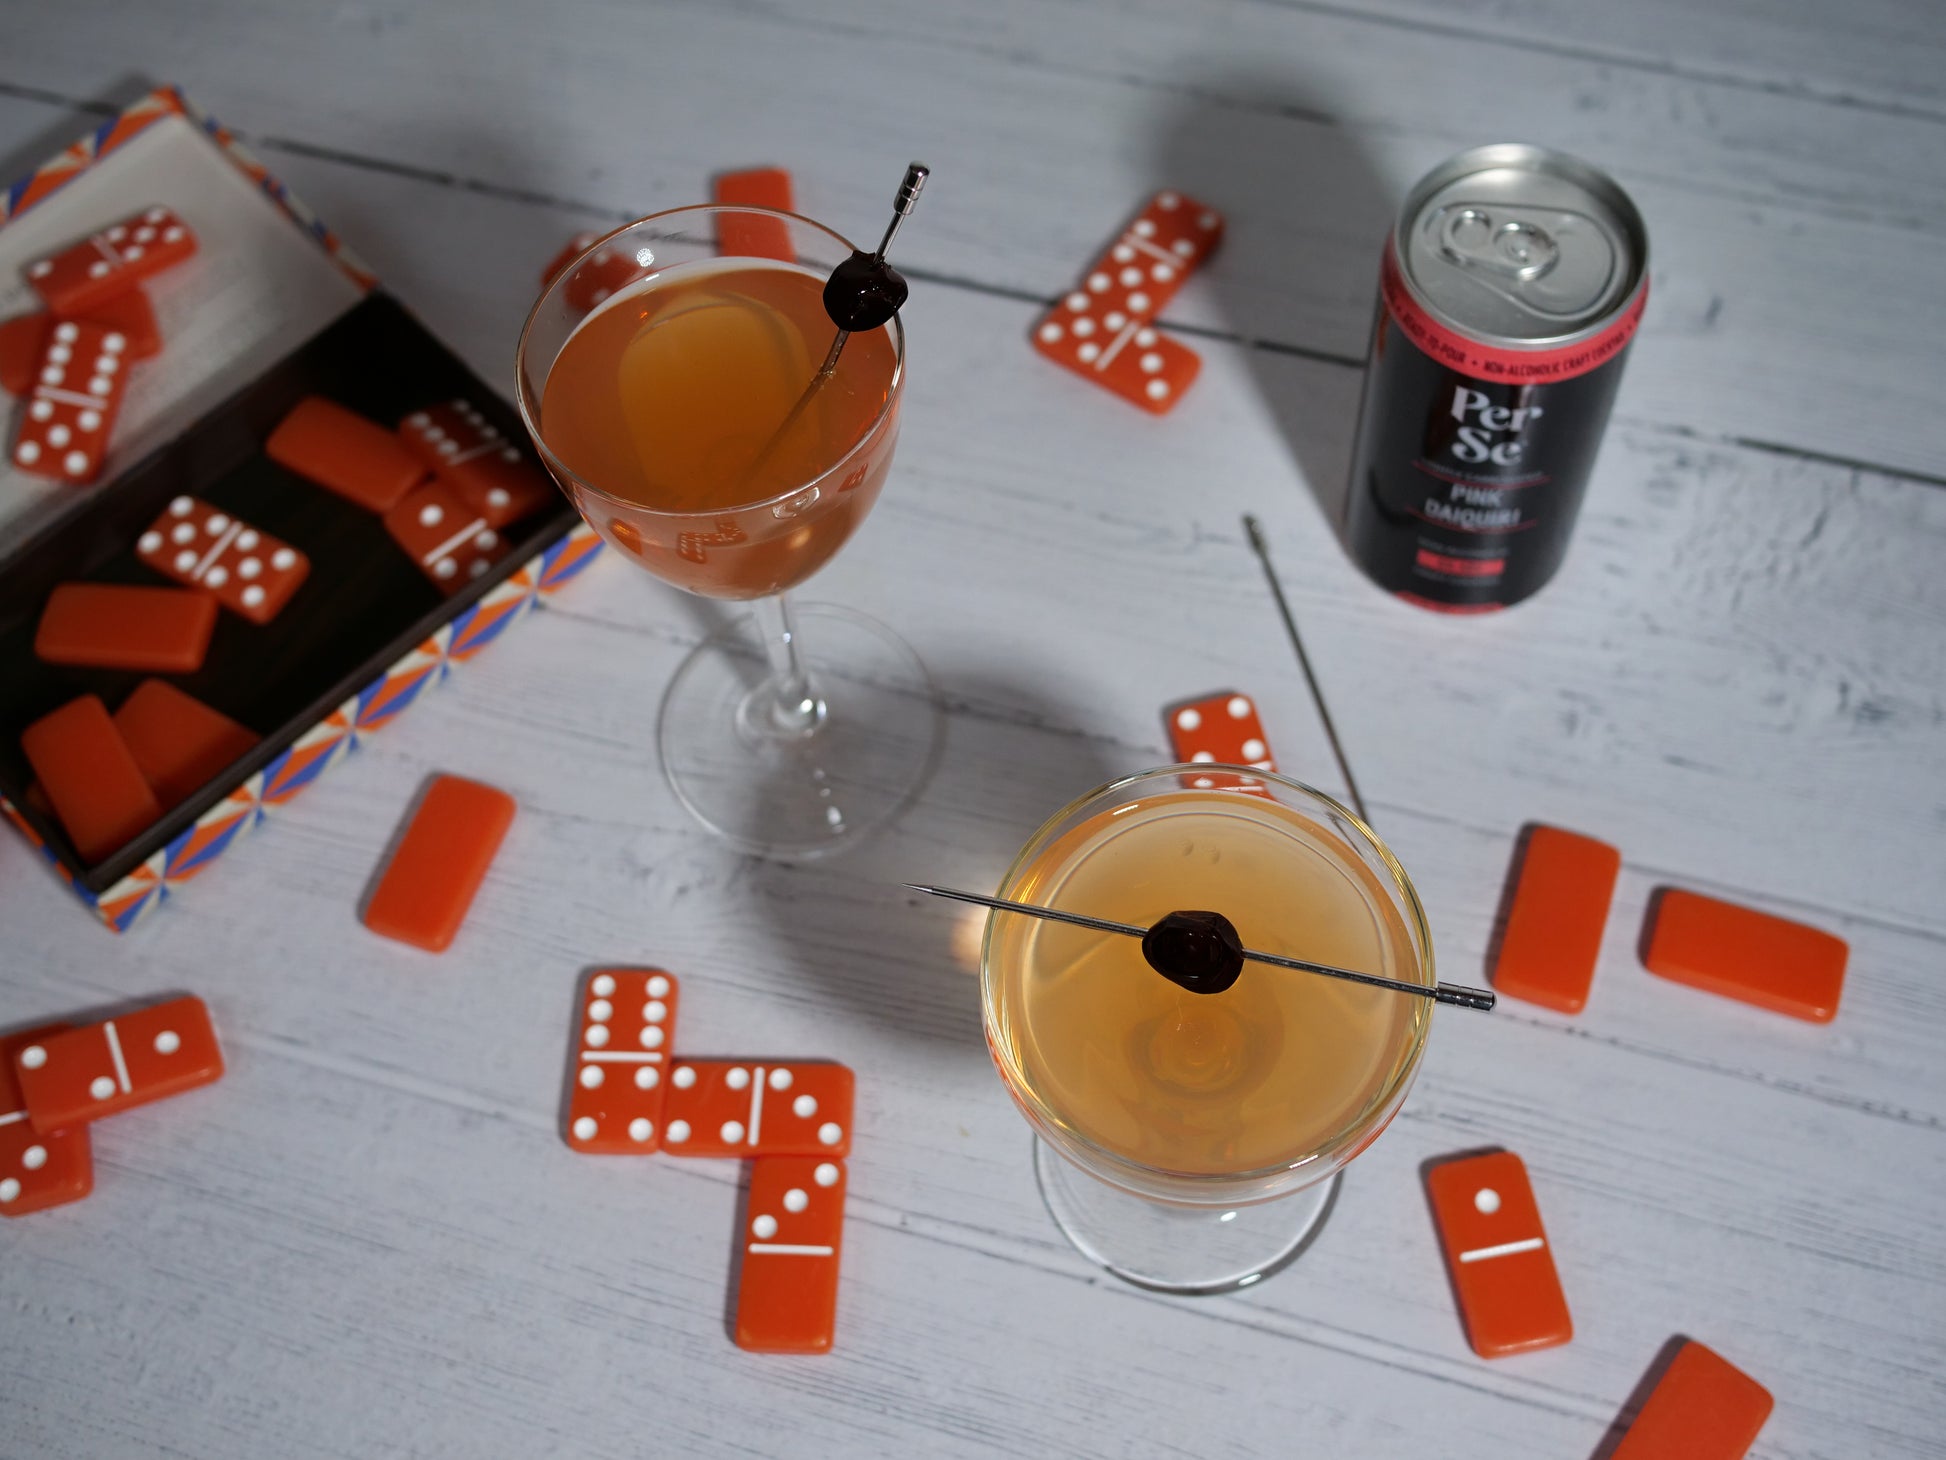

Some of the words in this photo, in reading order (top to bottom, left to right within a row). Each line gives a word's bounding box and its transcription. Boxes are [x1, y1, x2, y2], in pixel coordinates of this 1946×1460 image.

[1563, 352, 1590, 371] CRAFT
[1450, 385, 1543, 432] Per
[1451, 426, 1521, 466] Se
[1450, 483, 1504, 507] PINK
[1424, 498, 1521, 530] DAIQUIRI
